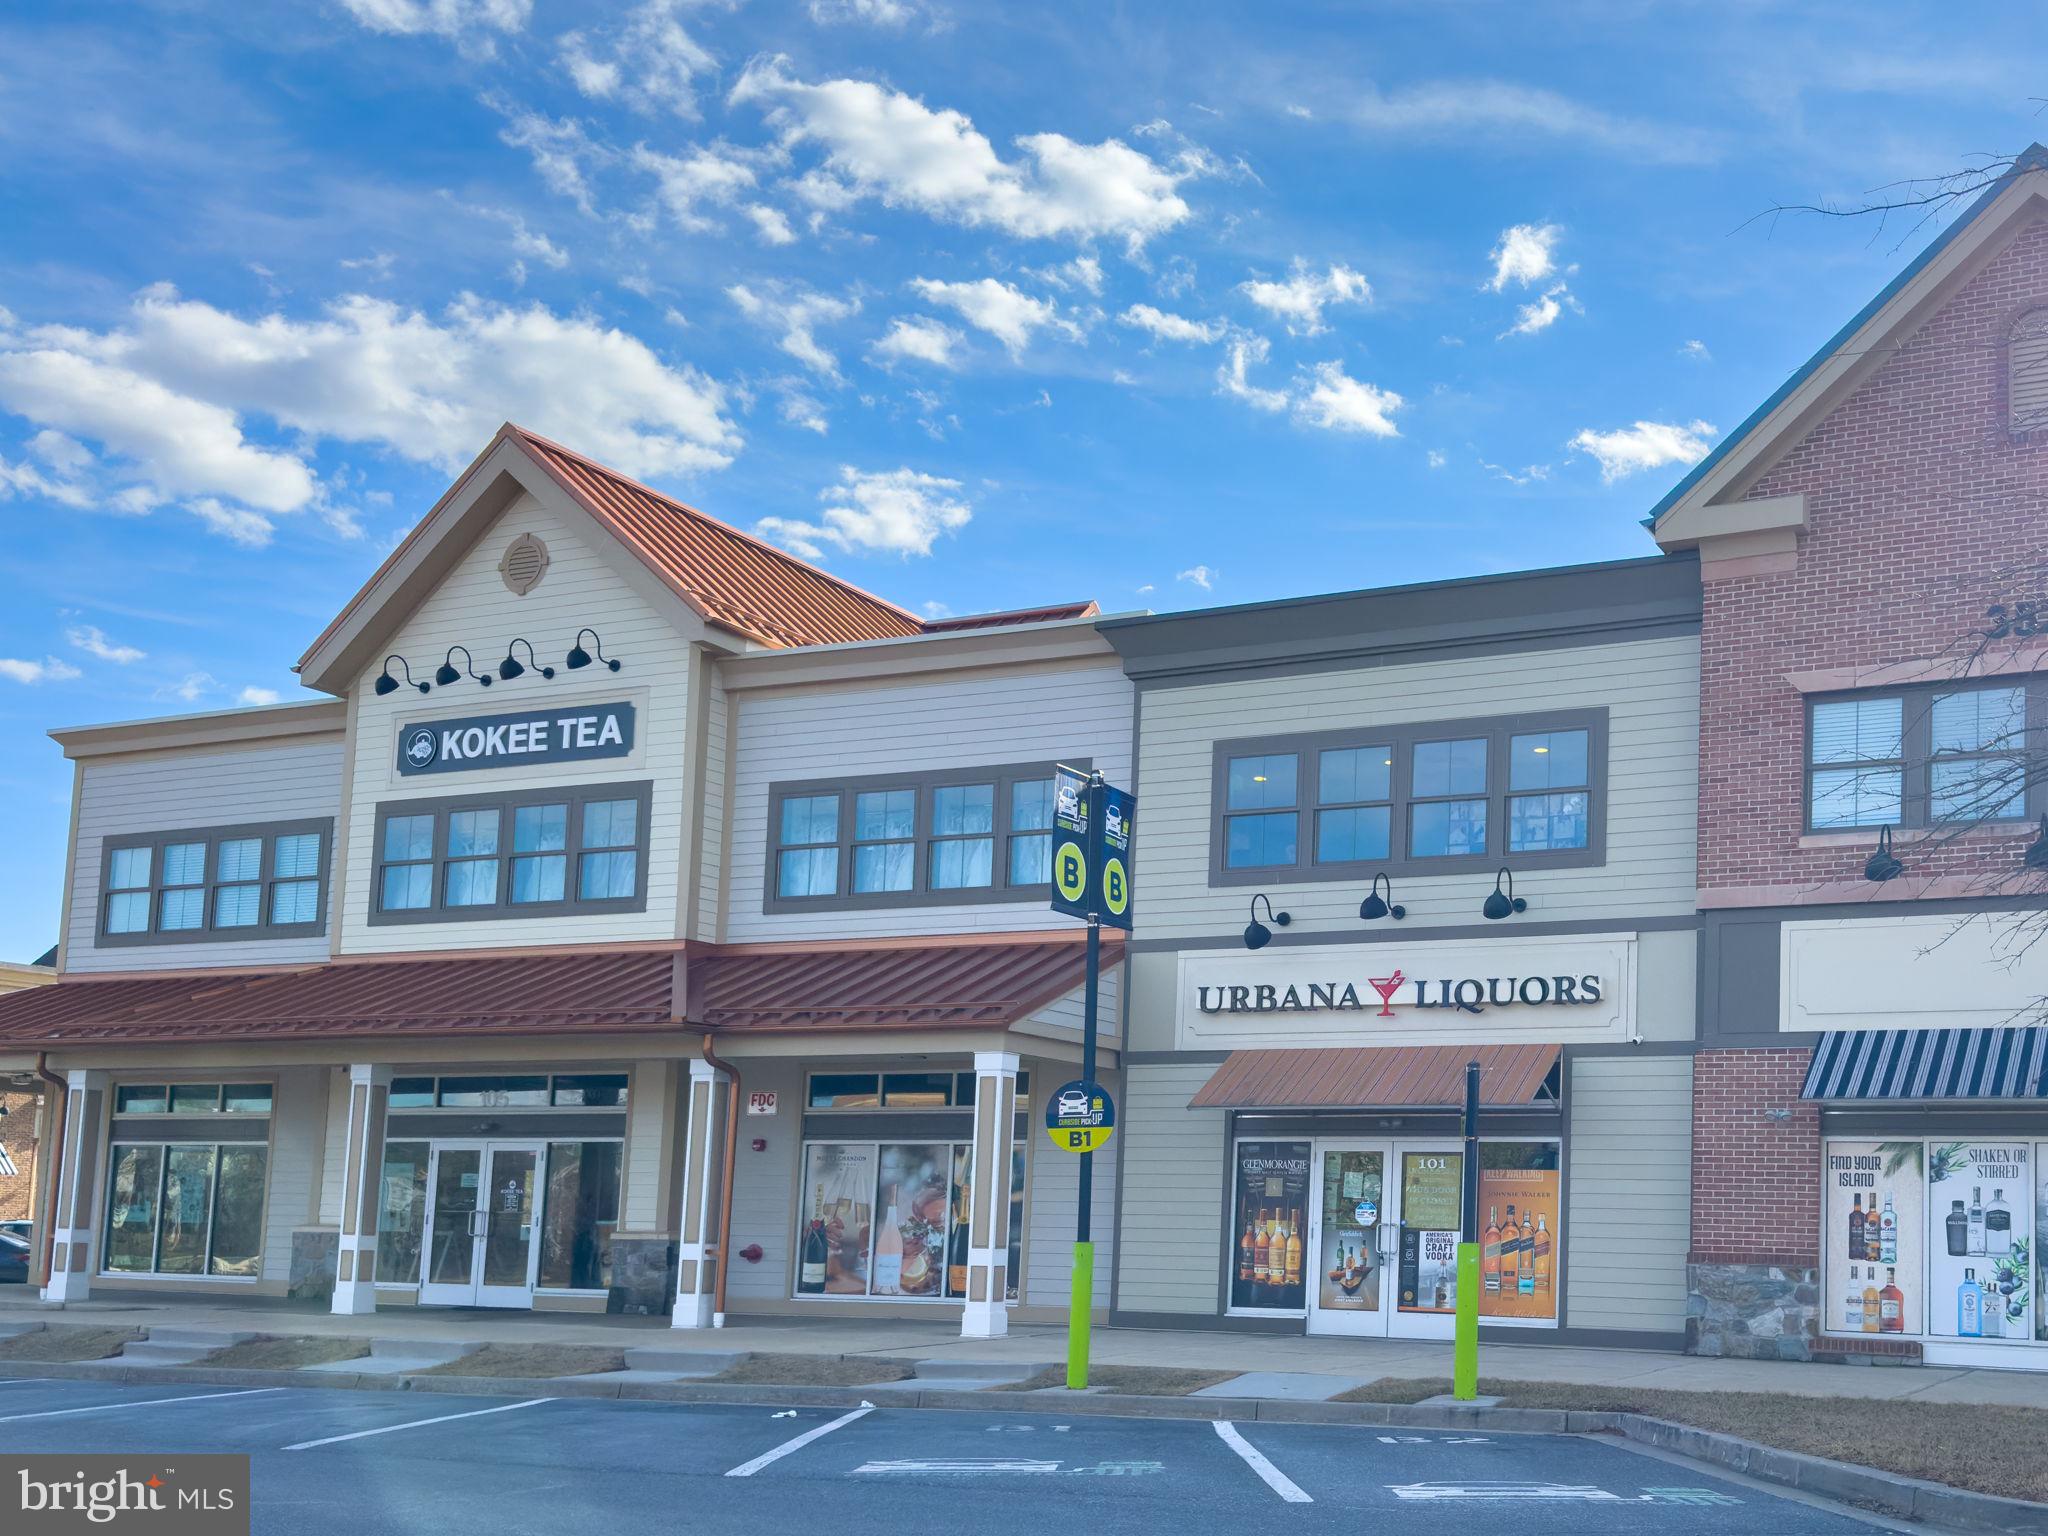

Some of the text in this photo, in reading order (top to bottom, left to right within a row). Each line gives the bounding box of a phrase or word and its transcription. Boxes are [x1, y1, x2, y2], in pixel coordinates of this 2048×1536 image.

[441, 714, 624, 761] KOKEE TEA
[1063, 855, 1079, 889] B
[1110, 870, 1123, 903] B
[1197, 975, 1602, 1014] URBANA LIQUORS
[479, 1090, 510, 1107] 105
[751, 1093, 775, 1107] FDC
[1069, 1131, 1091, 1147] B1
[1419, 1158, 1446, 1169] 101
[1830, 1155, 1881, 1170] FIND YOUR
[1969, 1149, 2027, 1163] SHAKEN OR
[1242, 1159, 1308, 1169] GLENMORANGIE
[1977, 1165, 2019, 1178] STIRRED
[1839, 1172, 1875, 1187] ISLAND
[1425, 1243, 1454, 1252] CRAFT
[1425, 1252, 1454, 1260] VODKA
